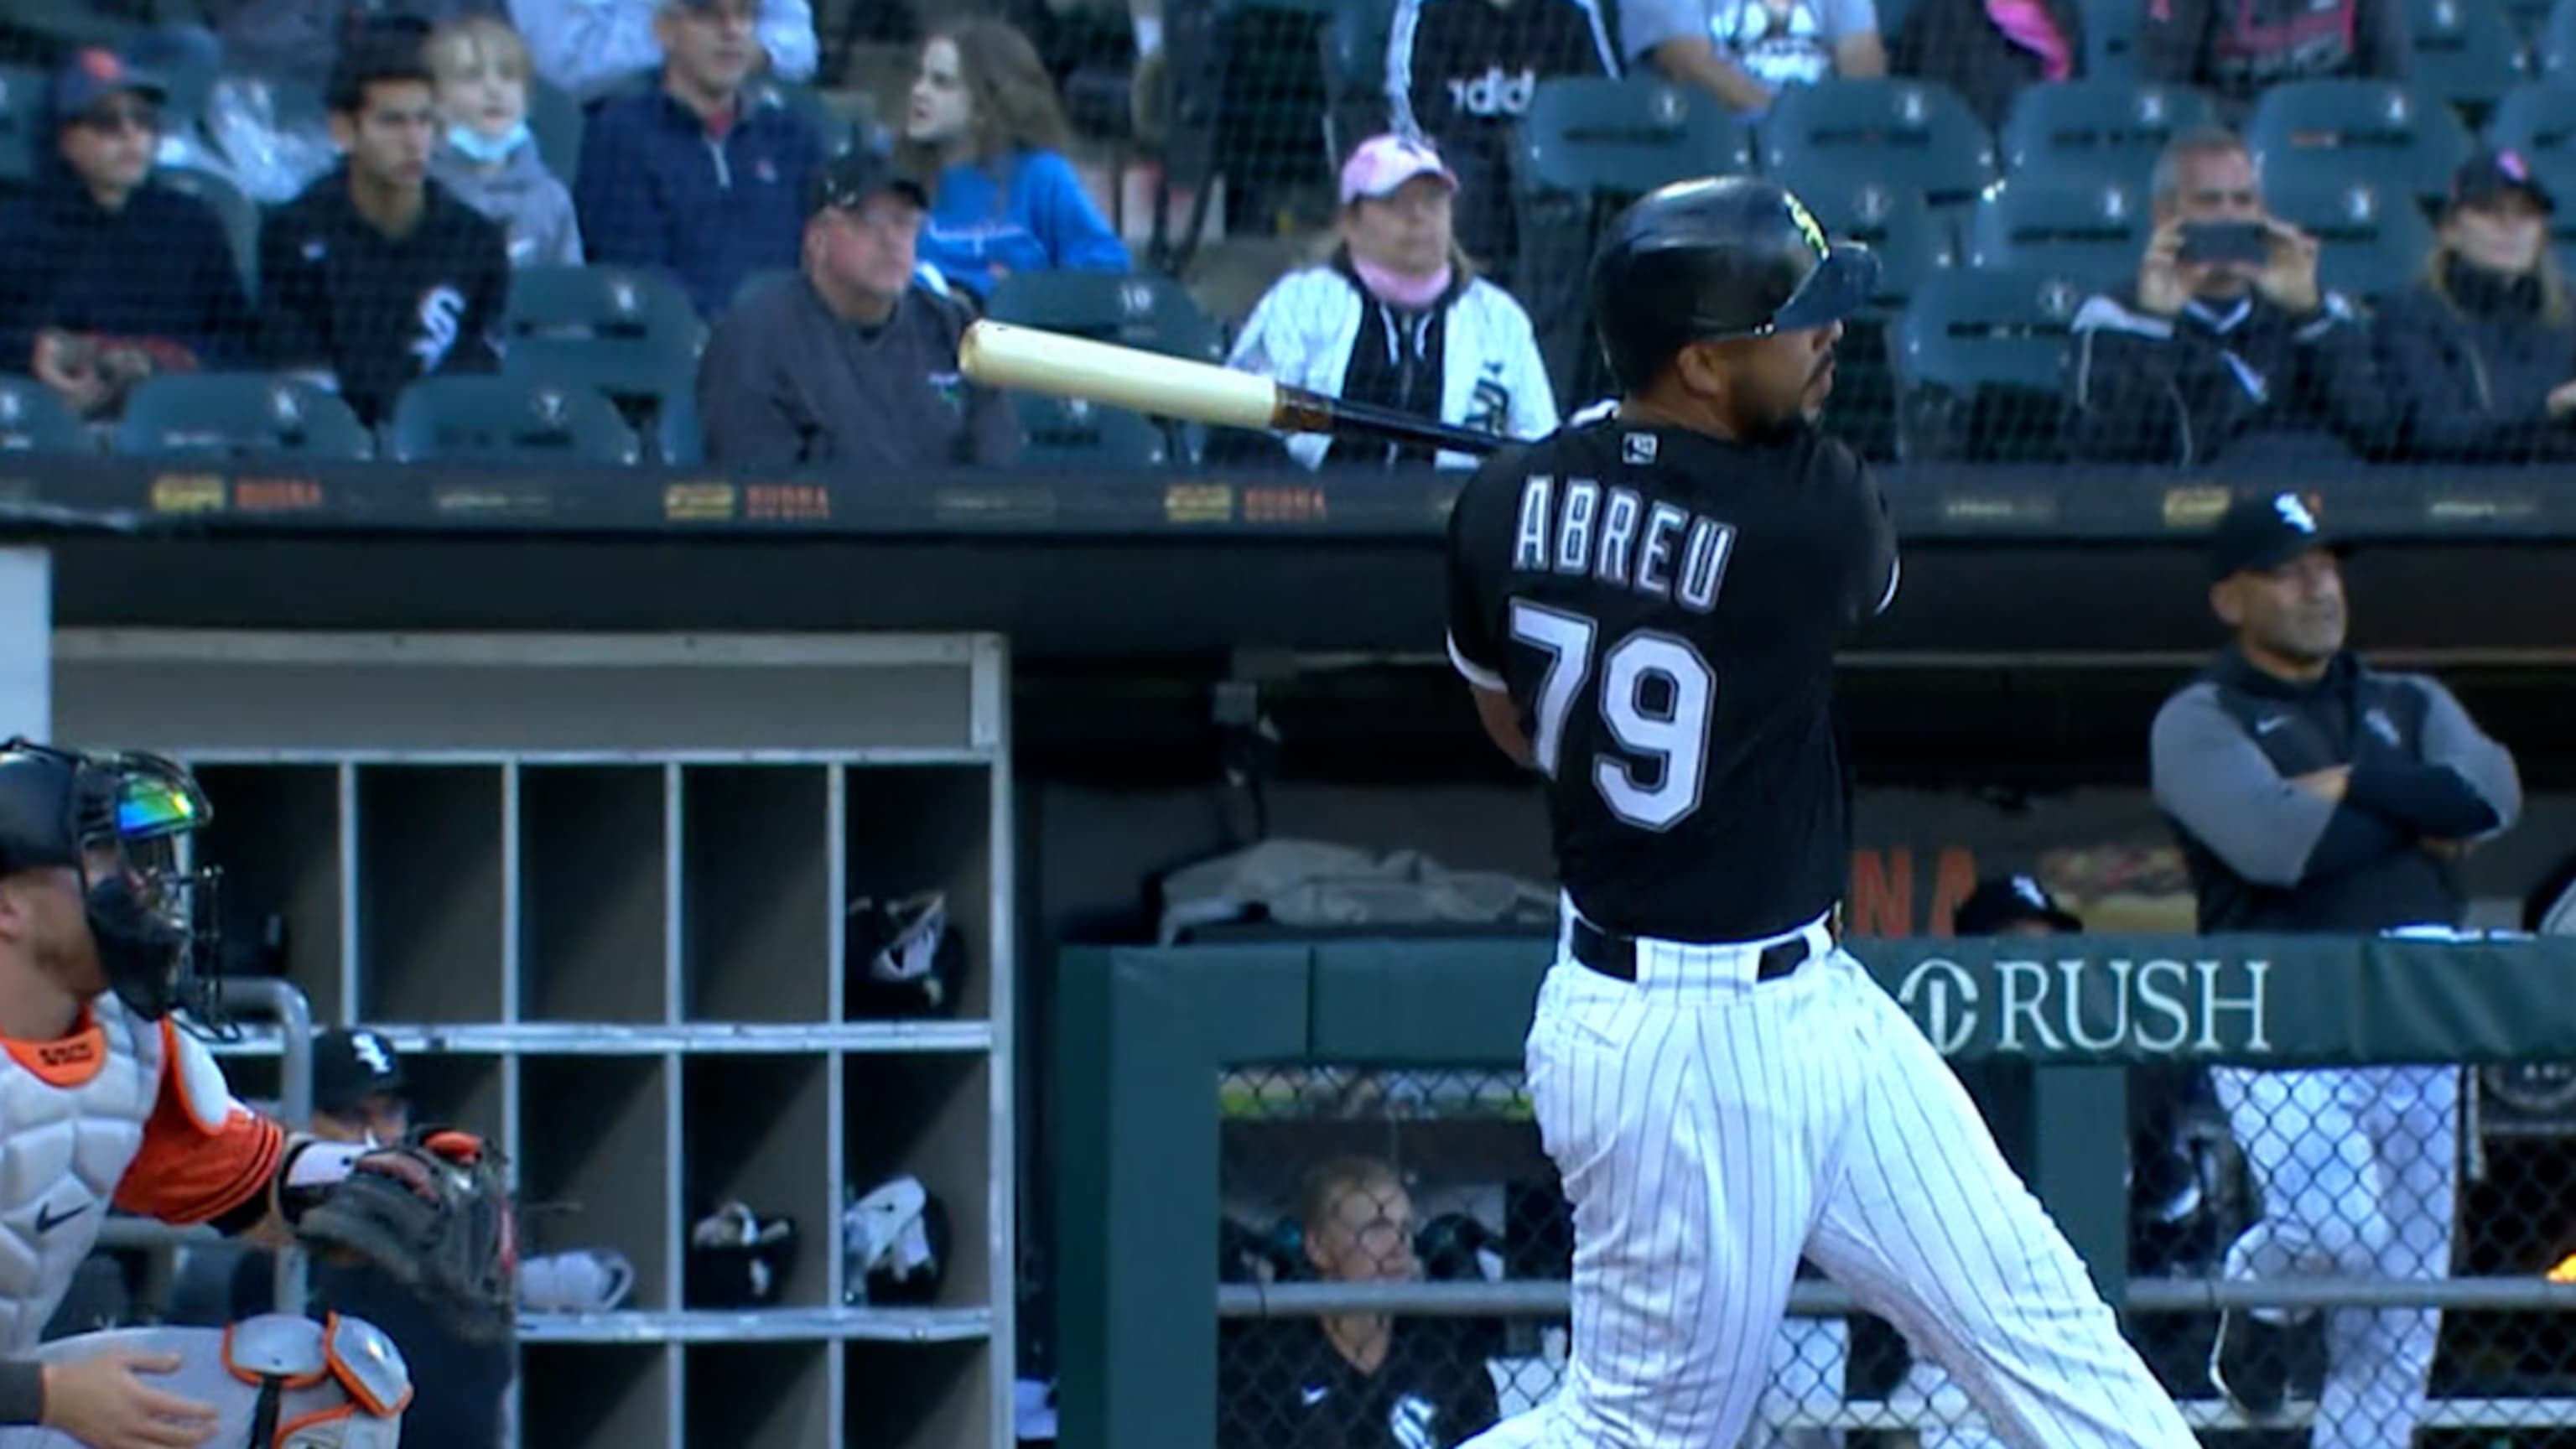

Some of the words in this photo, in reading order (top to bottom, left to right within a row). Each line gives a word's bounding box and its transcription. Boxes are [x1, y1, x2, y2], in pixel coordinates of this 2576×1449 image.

[1512, 475, 1737, 615] ABREU
[1510, 596, 1716, 833] 79
[1993, 959, 2272, 1052] RUSH
